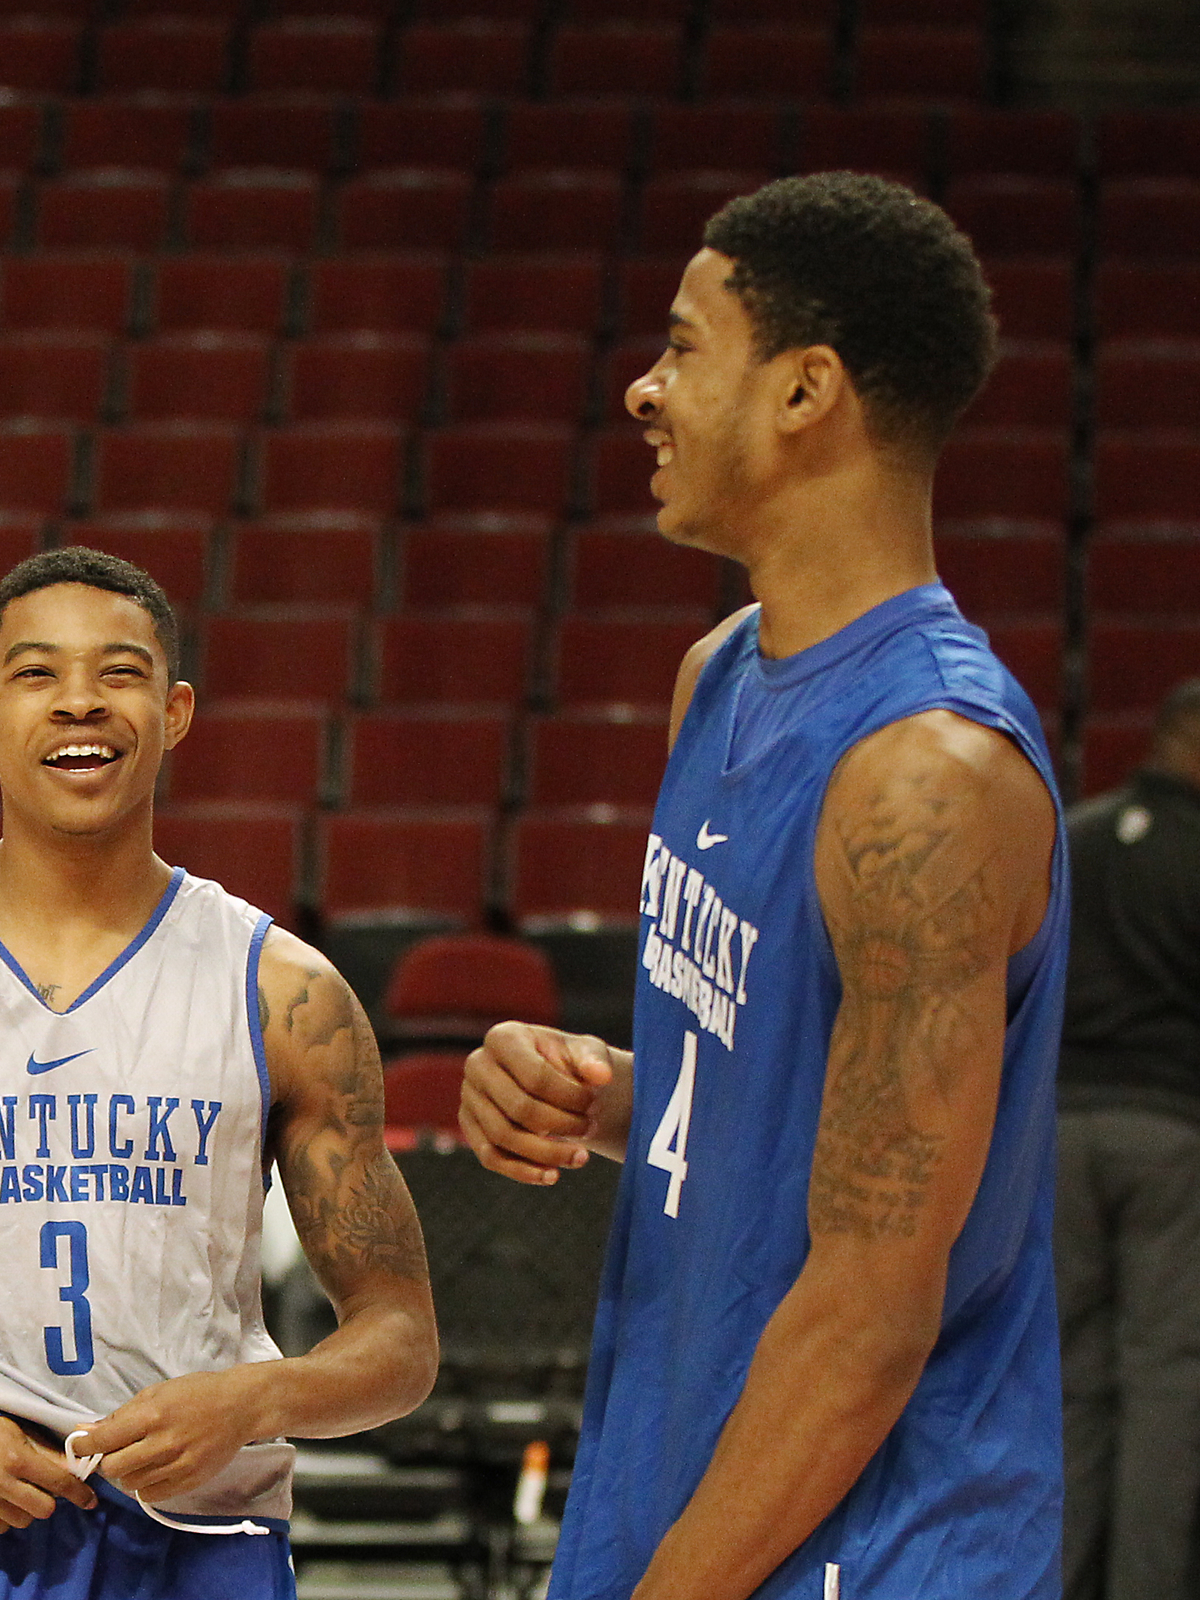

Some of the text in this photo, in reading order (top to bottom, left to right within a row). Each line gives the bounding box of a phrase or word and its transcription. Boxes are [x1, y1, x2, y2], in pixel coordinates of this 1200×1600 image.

[643, 922, 736, 1051] BASBALL
[647, 1030, 698, 1219] 4
[40, 1221, 94, 1376] 3
